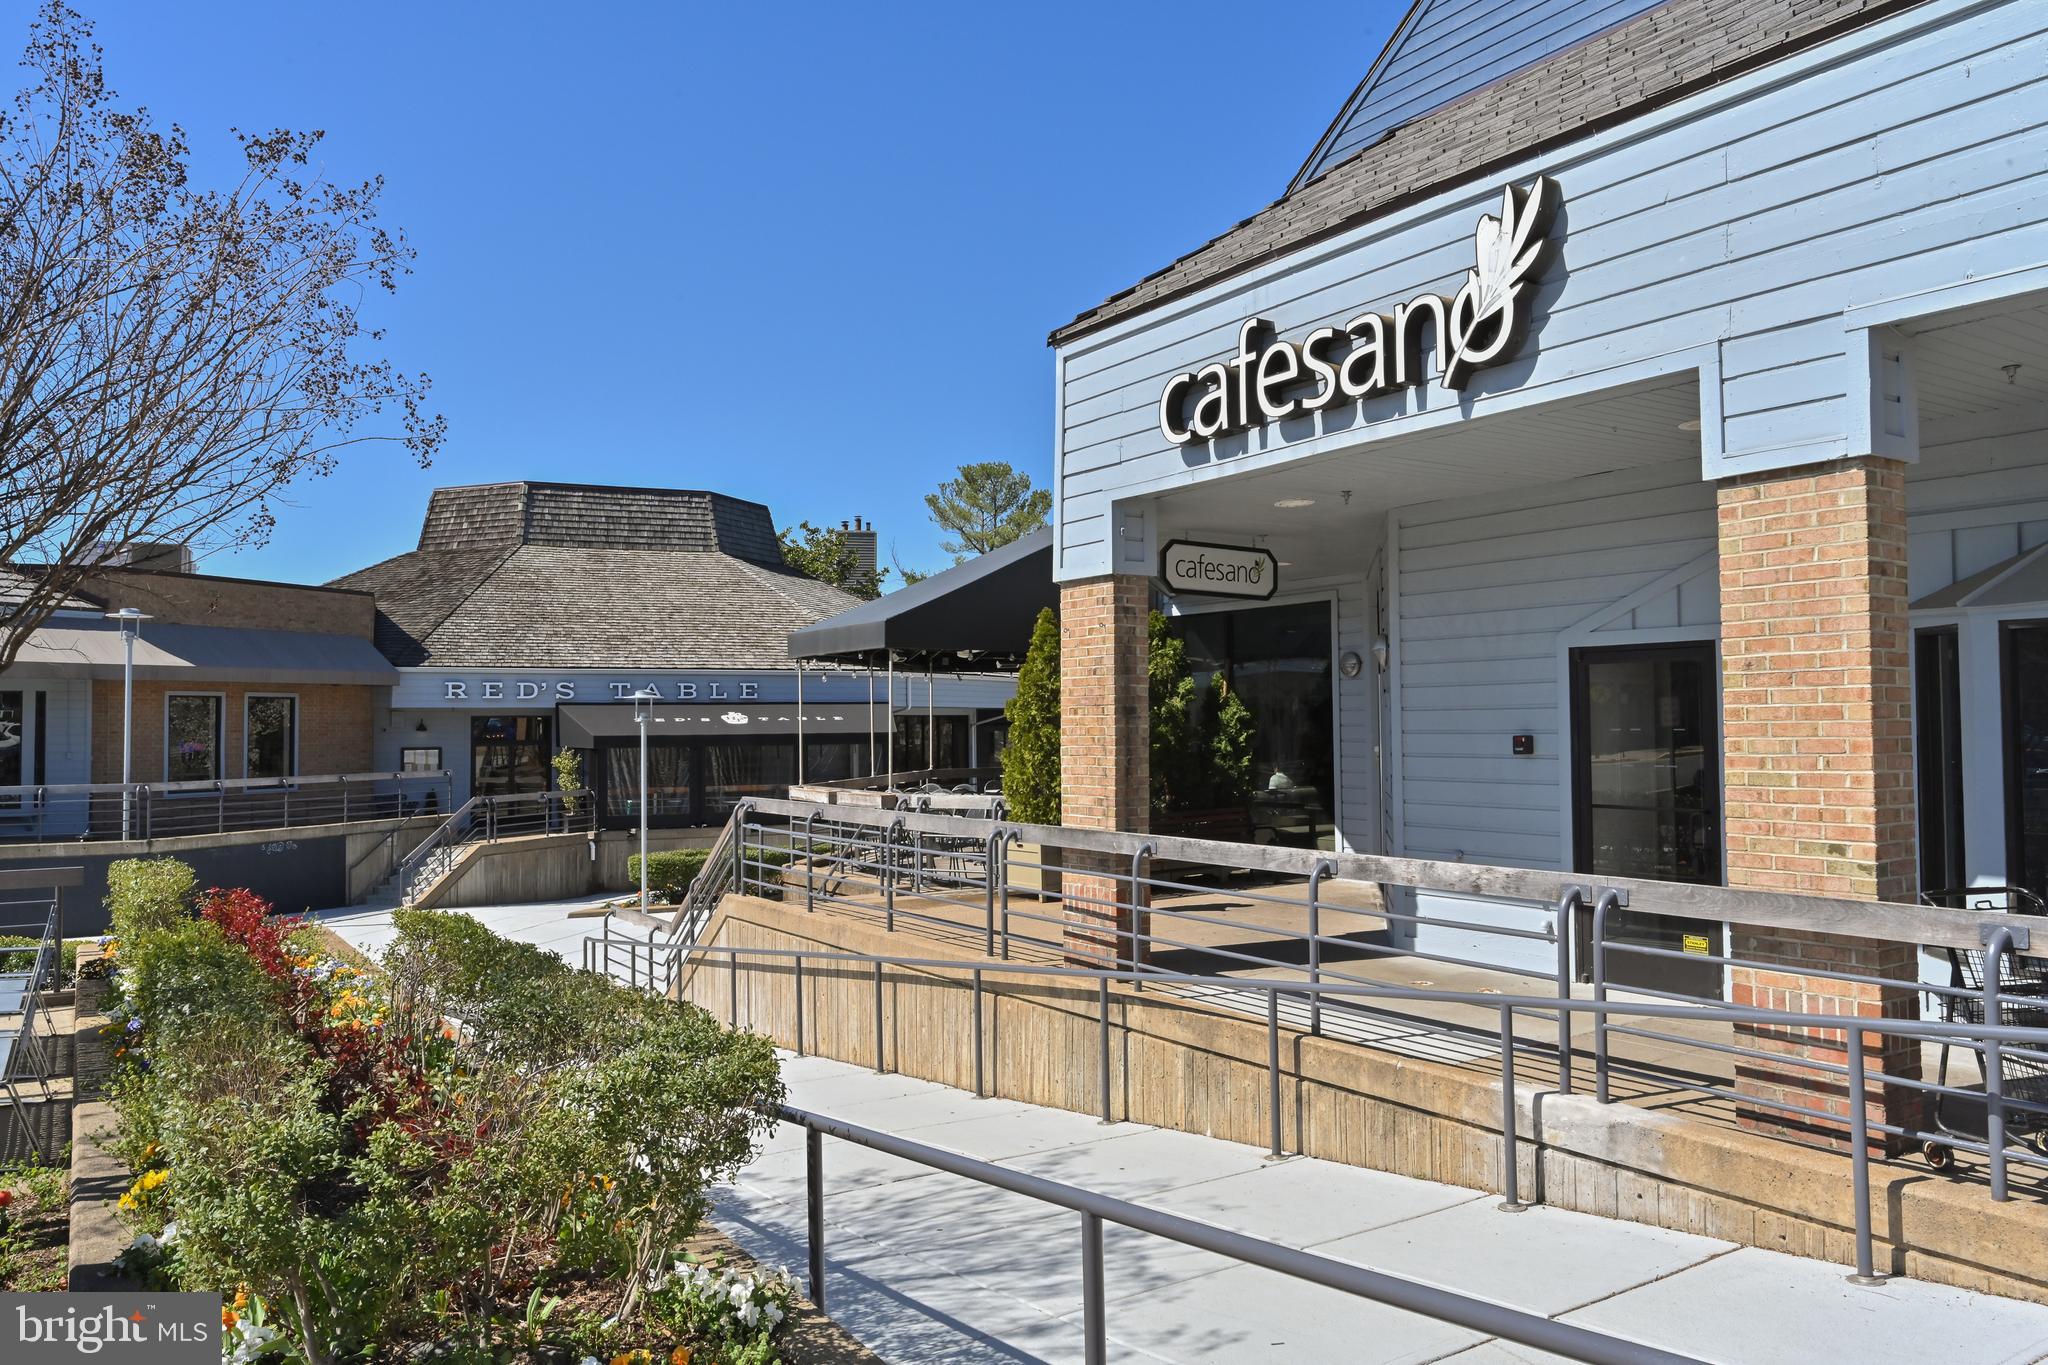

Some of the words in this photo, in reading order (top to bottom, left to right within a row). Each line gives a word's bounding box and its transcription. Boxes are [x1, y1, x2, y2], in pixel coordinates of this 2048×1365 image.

[1159, 278, 1517, 445] cafesano
[1175, 553, 1261, 585] cafesano
[444, 681, 576, 700] RED'S
[609, 682, 758, 700] TABLE
